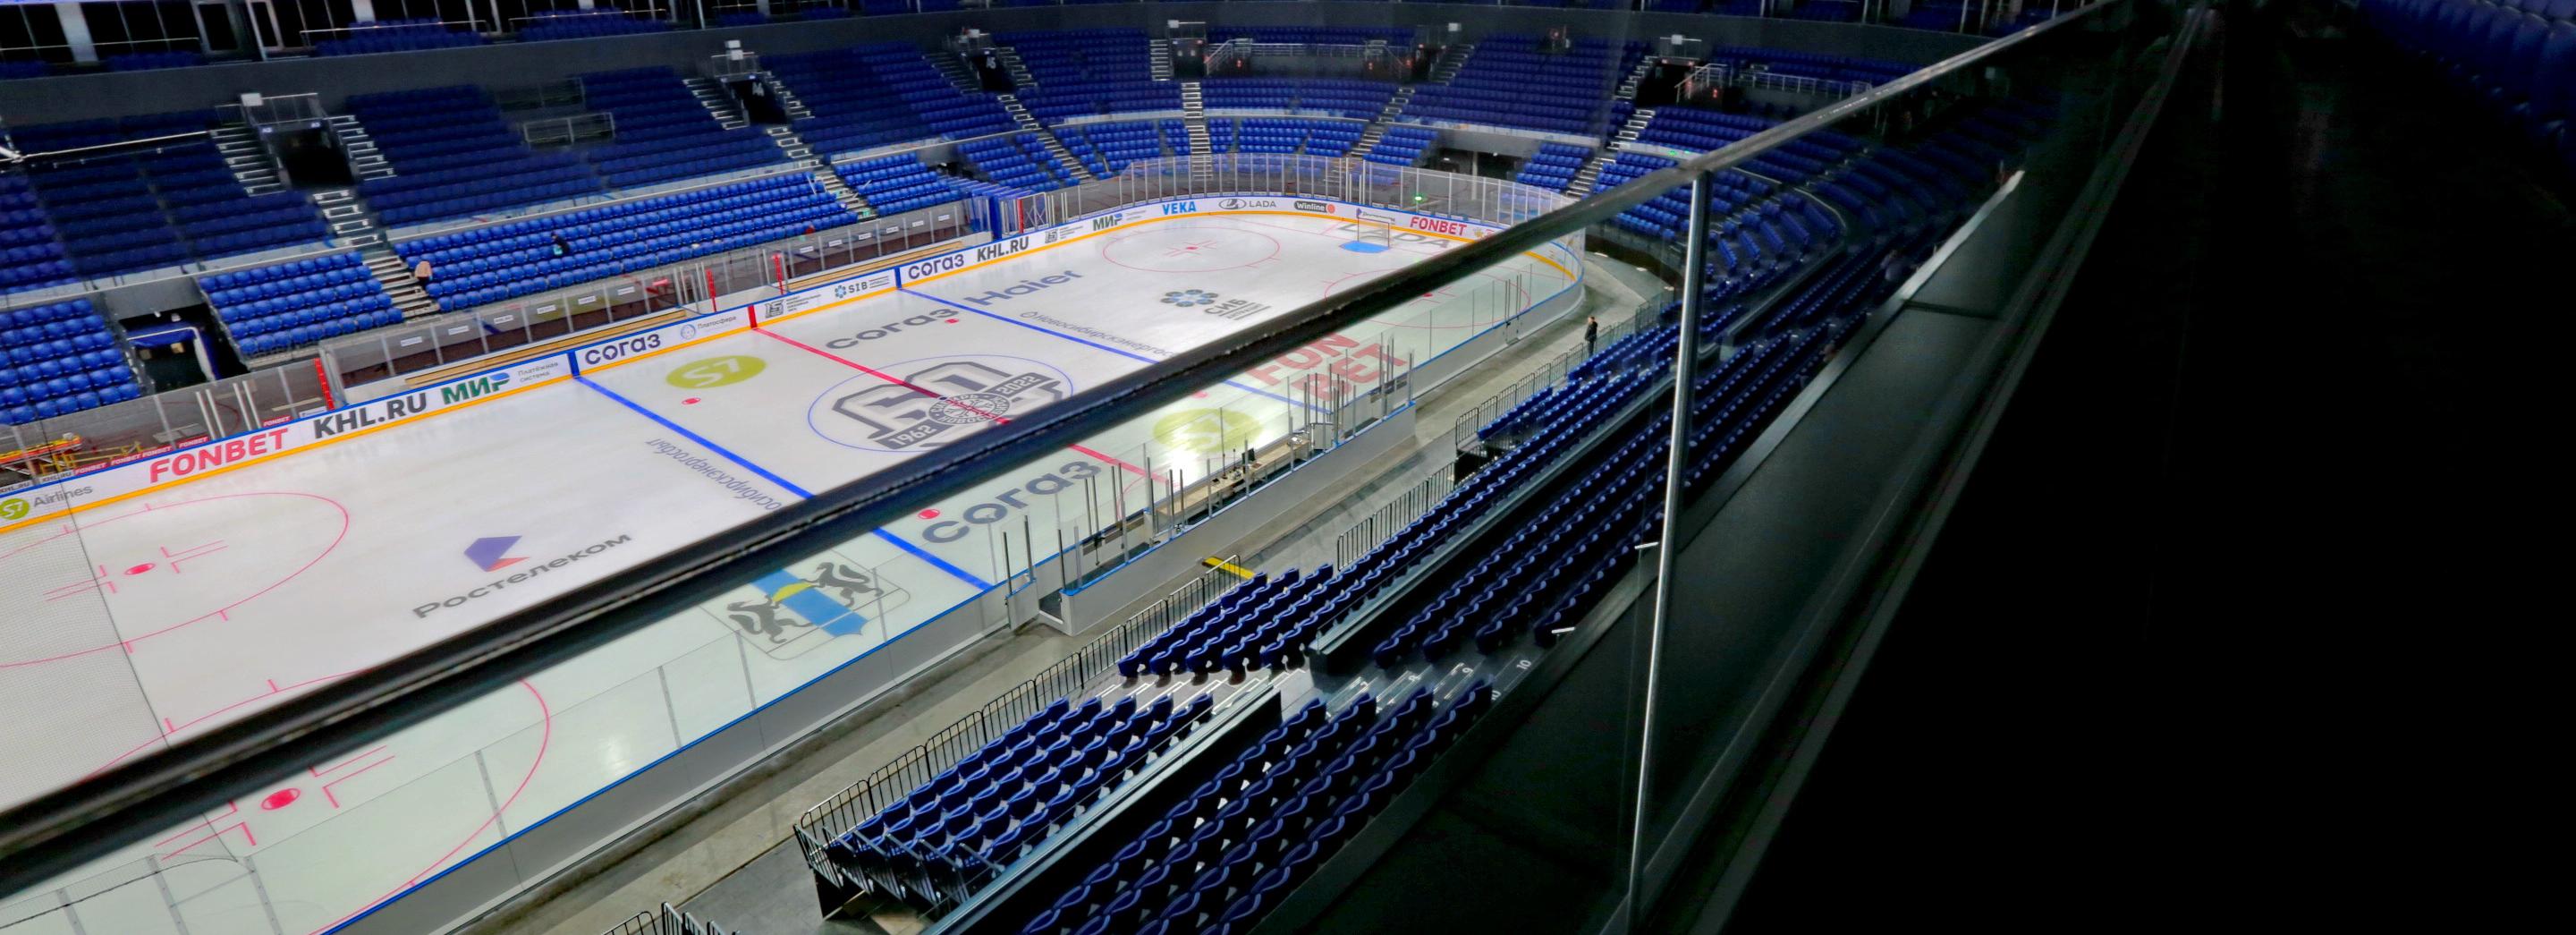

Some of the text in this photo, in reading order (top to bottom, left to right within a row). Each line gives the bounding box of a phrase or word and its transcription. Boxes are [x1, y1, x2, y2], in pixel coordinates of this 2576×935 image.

[1162, 200, 1197, 215] VEKA
[1249, 200, 1276, 208] LADA
[1296, 202, 1326, 212] Winline
[1410, 217, 1467, 236] FONBET
[977, 236, 1030, 262] KHL.RU
[849, 281, 868, 293] SIB
[963, 270, 1084, 306] Haier
[1204, 299, 1248, 315] СИБ
[442, 372, 510, 404] МИР
[998, 375, 1041, 395] 2022
[313, 393, 427, 438] KHL.RU
[893, 423, 938, 446] 1962
[150, 428, 288, 484] FONBET
[33, 486, 94, 507] Airlines
[412, 534, 632, 618] Ростелеком
[1516, 659, 1532, 670] 10
